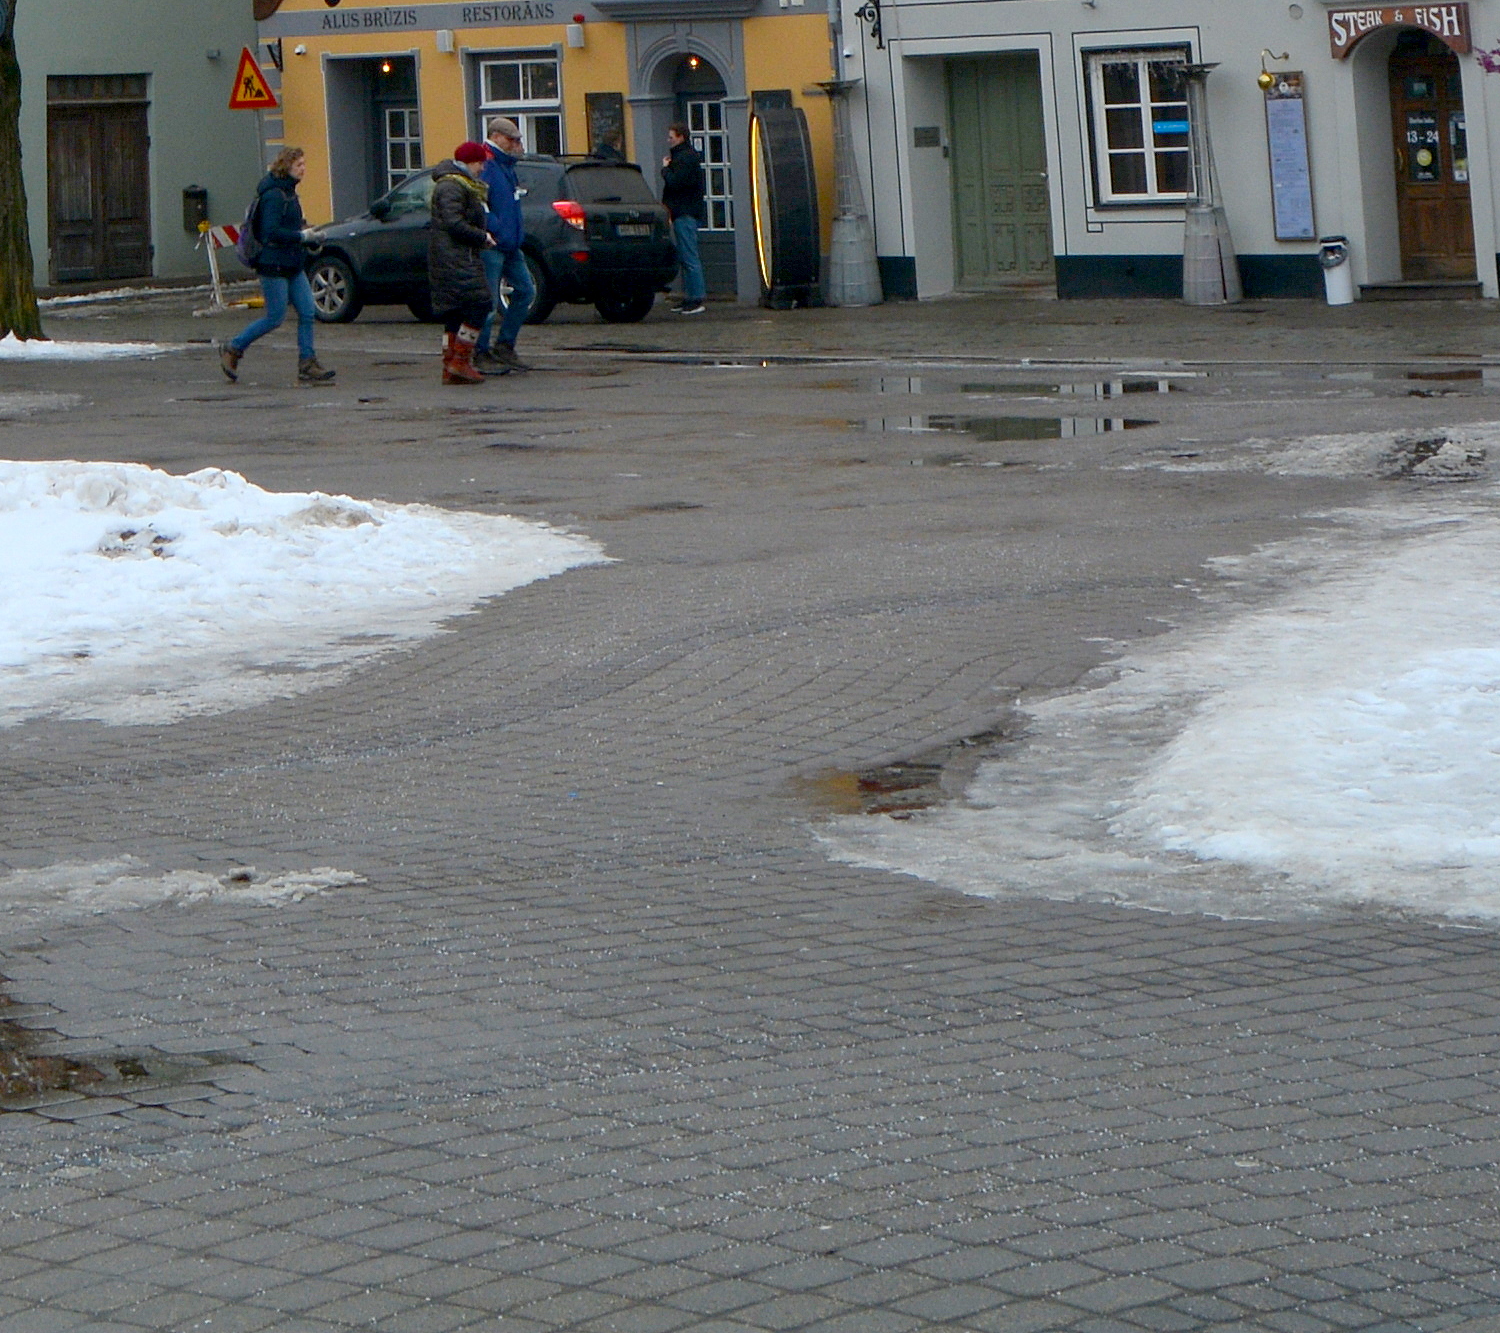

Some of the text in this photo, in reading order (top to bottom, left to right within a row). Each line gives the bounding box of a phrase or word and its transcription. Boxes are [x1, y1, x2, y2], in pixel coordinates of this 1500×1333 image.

[322, 0, 555, 30] ALUS BRŪZIS RESTORĀNS
[1331, 6, 1461, 47] STEAK & FISH
[1406, 130, 1418, 143] 13
[1426, 130, 1439, 143] 24
